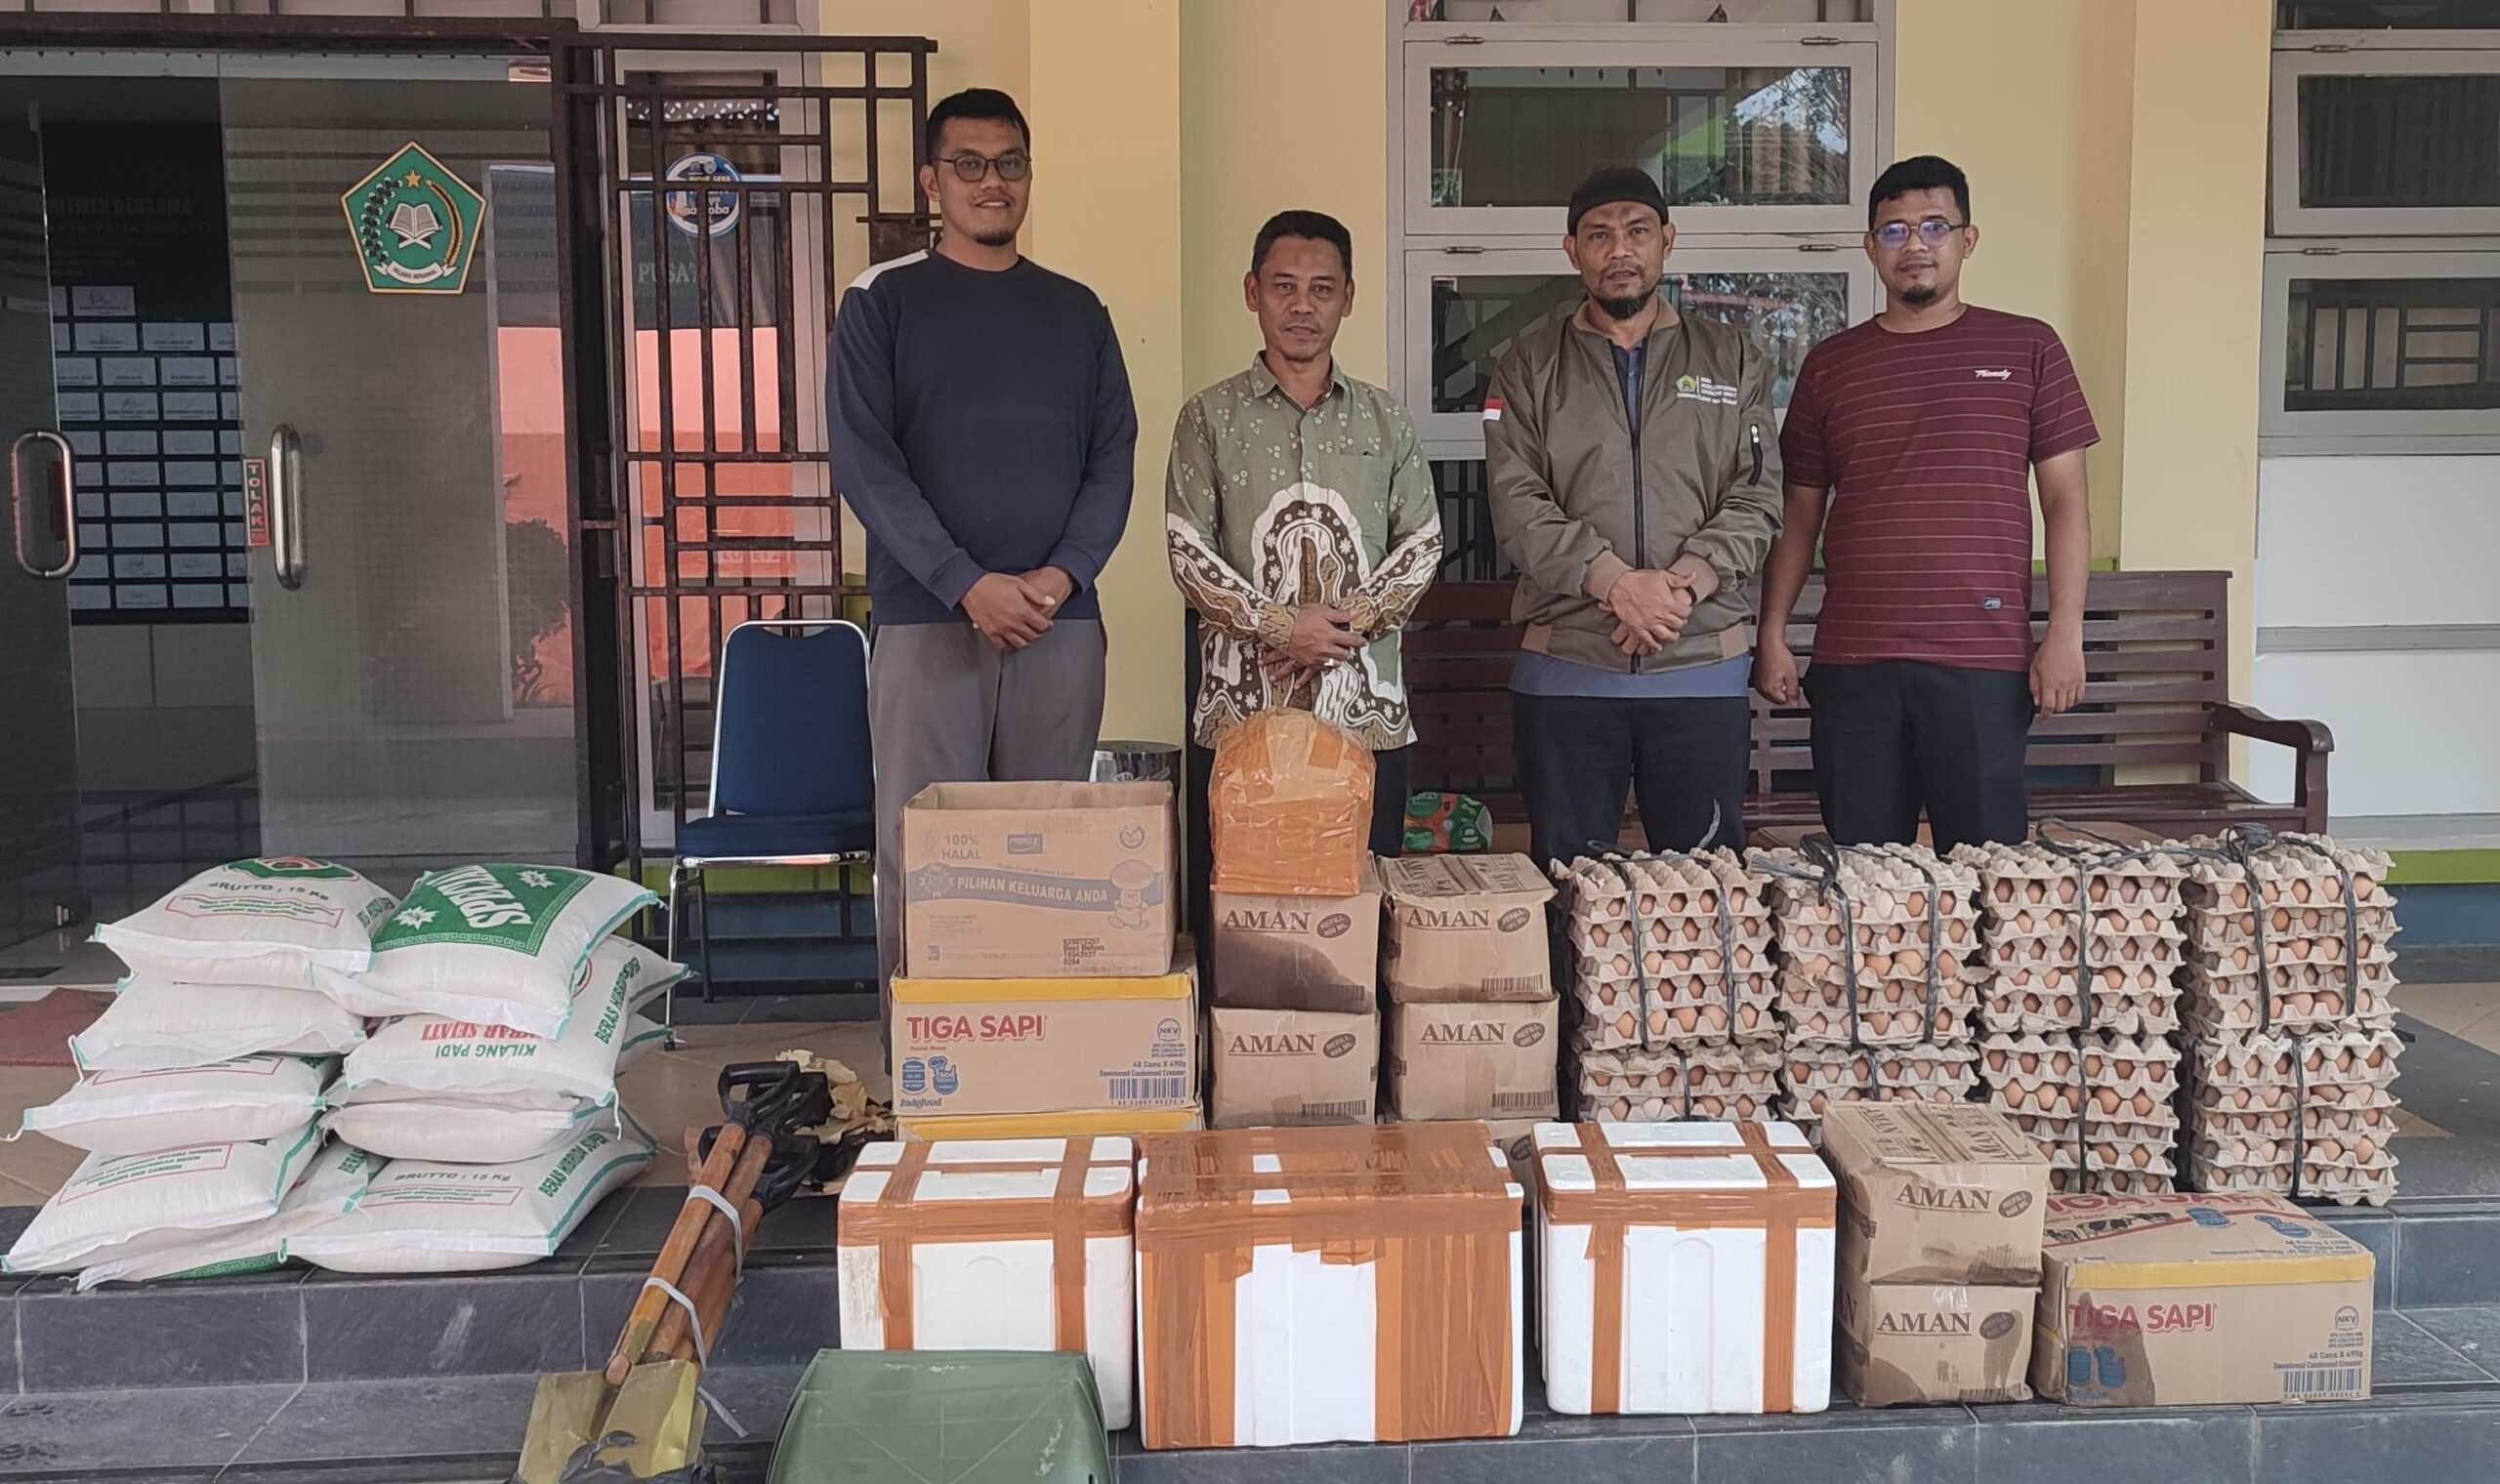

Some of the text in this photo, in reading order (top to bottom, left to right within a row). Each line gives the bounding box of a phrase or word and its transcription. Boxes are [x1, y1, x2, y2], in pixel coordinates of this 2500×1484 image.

[248, 465, 265, 526] TOLAK
[943, 834, 979, 846] 100%
[941, 849, 982, 861] HALAL
[956, 877, 1006, 892] PILIHAN
[1008, 883, 1073, 903] KELUARGA
[1075, 888, 1108, 904] ANDA
[1223, 909, 1312, 931] AMAN
[1406, 909, 1490, 928] AMAN
[594, 1006, 620, 1046] BERAS
[905, 1014, 1043, 1039] TIGA SAPI
[1159, 1026, 1179, 1035] NKV
[1420, 1023, 1507, 1042] AMAN
[435, 1045, 537, 1058] KILANG PADI
[1229, 1034, 1316, 1052] AMAN
[900, 1096, 942, 1110] Indofood
[395, 1173, 458, 1181] BRUTTO
[1896, 1182, 1993, 1210] AMAN
[1877, 1312, 1972, 1332] AMAN
[2068, 1303, 2212, 1330] TIGA SAPI
